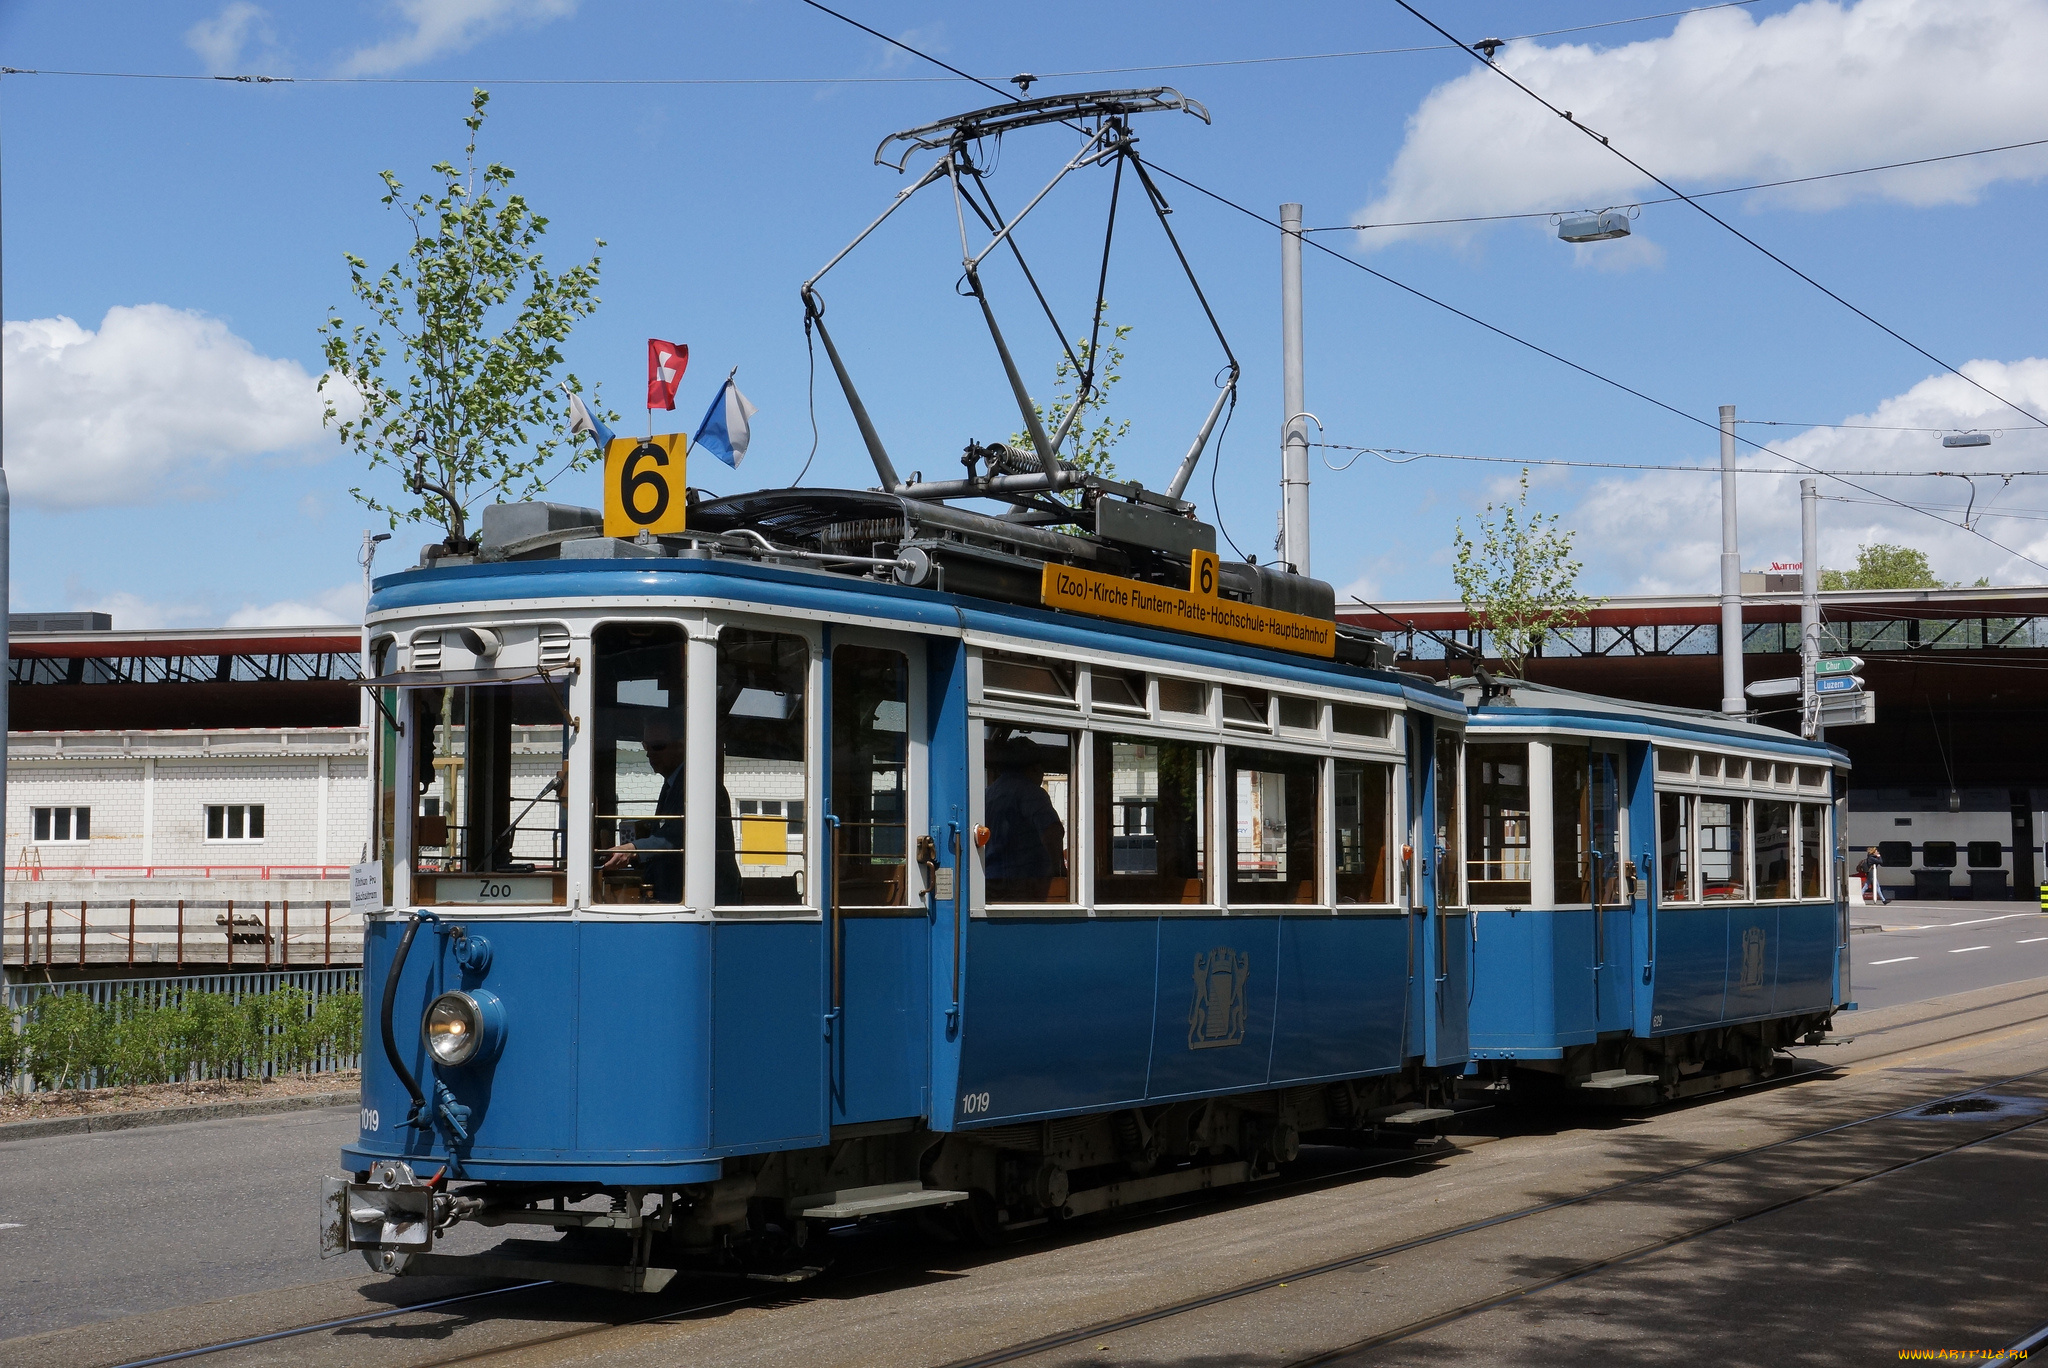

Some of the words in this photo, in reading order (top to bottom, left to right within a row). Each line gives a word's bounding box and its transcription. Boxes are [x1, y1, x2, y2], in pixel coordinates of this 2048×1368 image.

[621, 443, 669, 525] 6
[1200, 557, 1213, 594] 6
[1057, 572, 1128, 606] (Zoo)-Kirche
[1131, 590, 1328, 644] Fluntern-Platte-Hochschule-Hauptbahnhof
[1826, 661, 1840, 670] Chur
[1823, 680, 1844, 690] Luzern
[480, 880, 511, 898] Zoo
[962, 1092, 990, 1113] 1019
[361, 1108, 379, 1131] 1019
